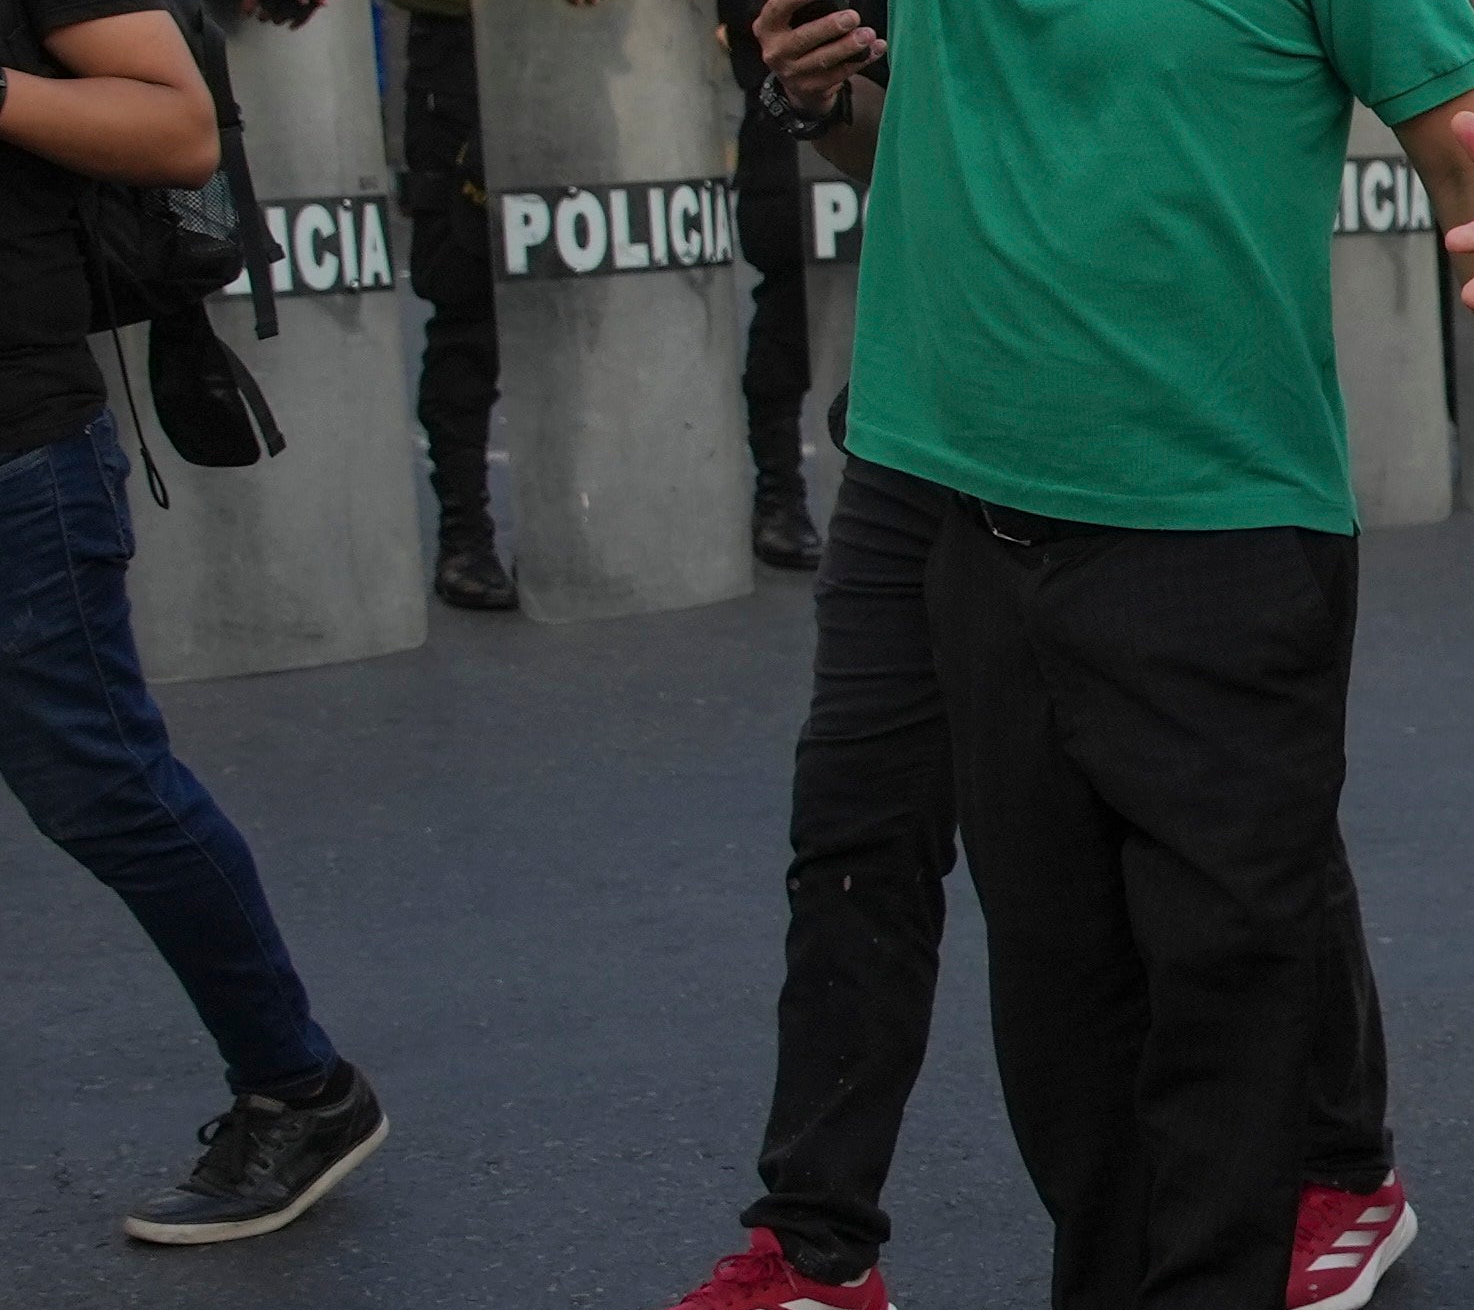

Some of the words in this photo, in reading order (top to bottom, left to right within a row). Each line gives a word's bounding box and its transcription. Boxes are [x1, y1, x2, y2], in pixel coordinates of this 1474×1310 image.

[502, 183, 732, 275] POLICIA
[1333, 159, 1431, 232] ICIA
[222, 202, 393, 295] ICIA
